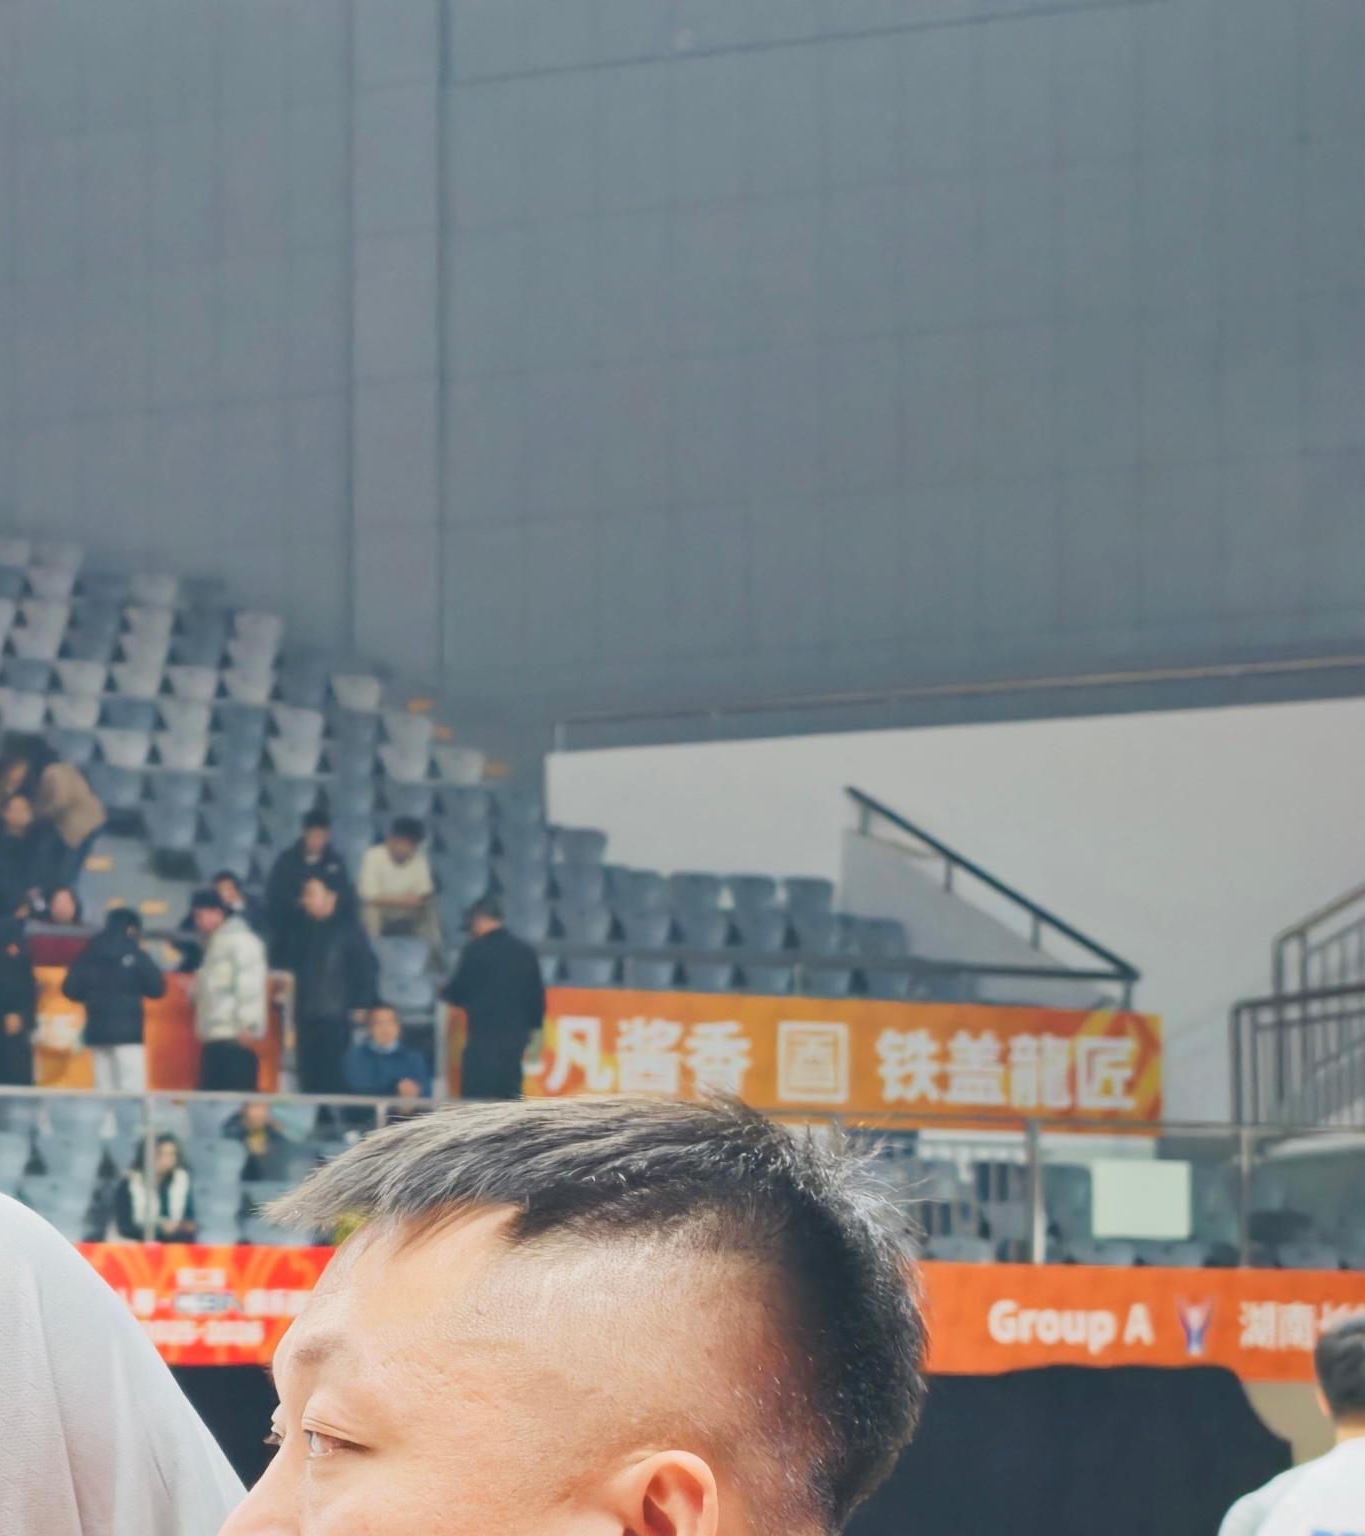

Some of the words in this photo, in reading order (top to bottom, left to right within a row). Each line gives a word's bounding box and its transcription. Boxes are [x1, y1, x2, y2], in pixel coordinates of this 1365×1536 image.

[522, 1015, 752, 1098] 凡酱香
[988, 1300, 1117, 1355] Group
[1123, 1303, 1155, 1345] A
